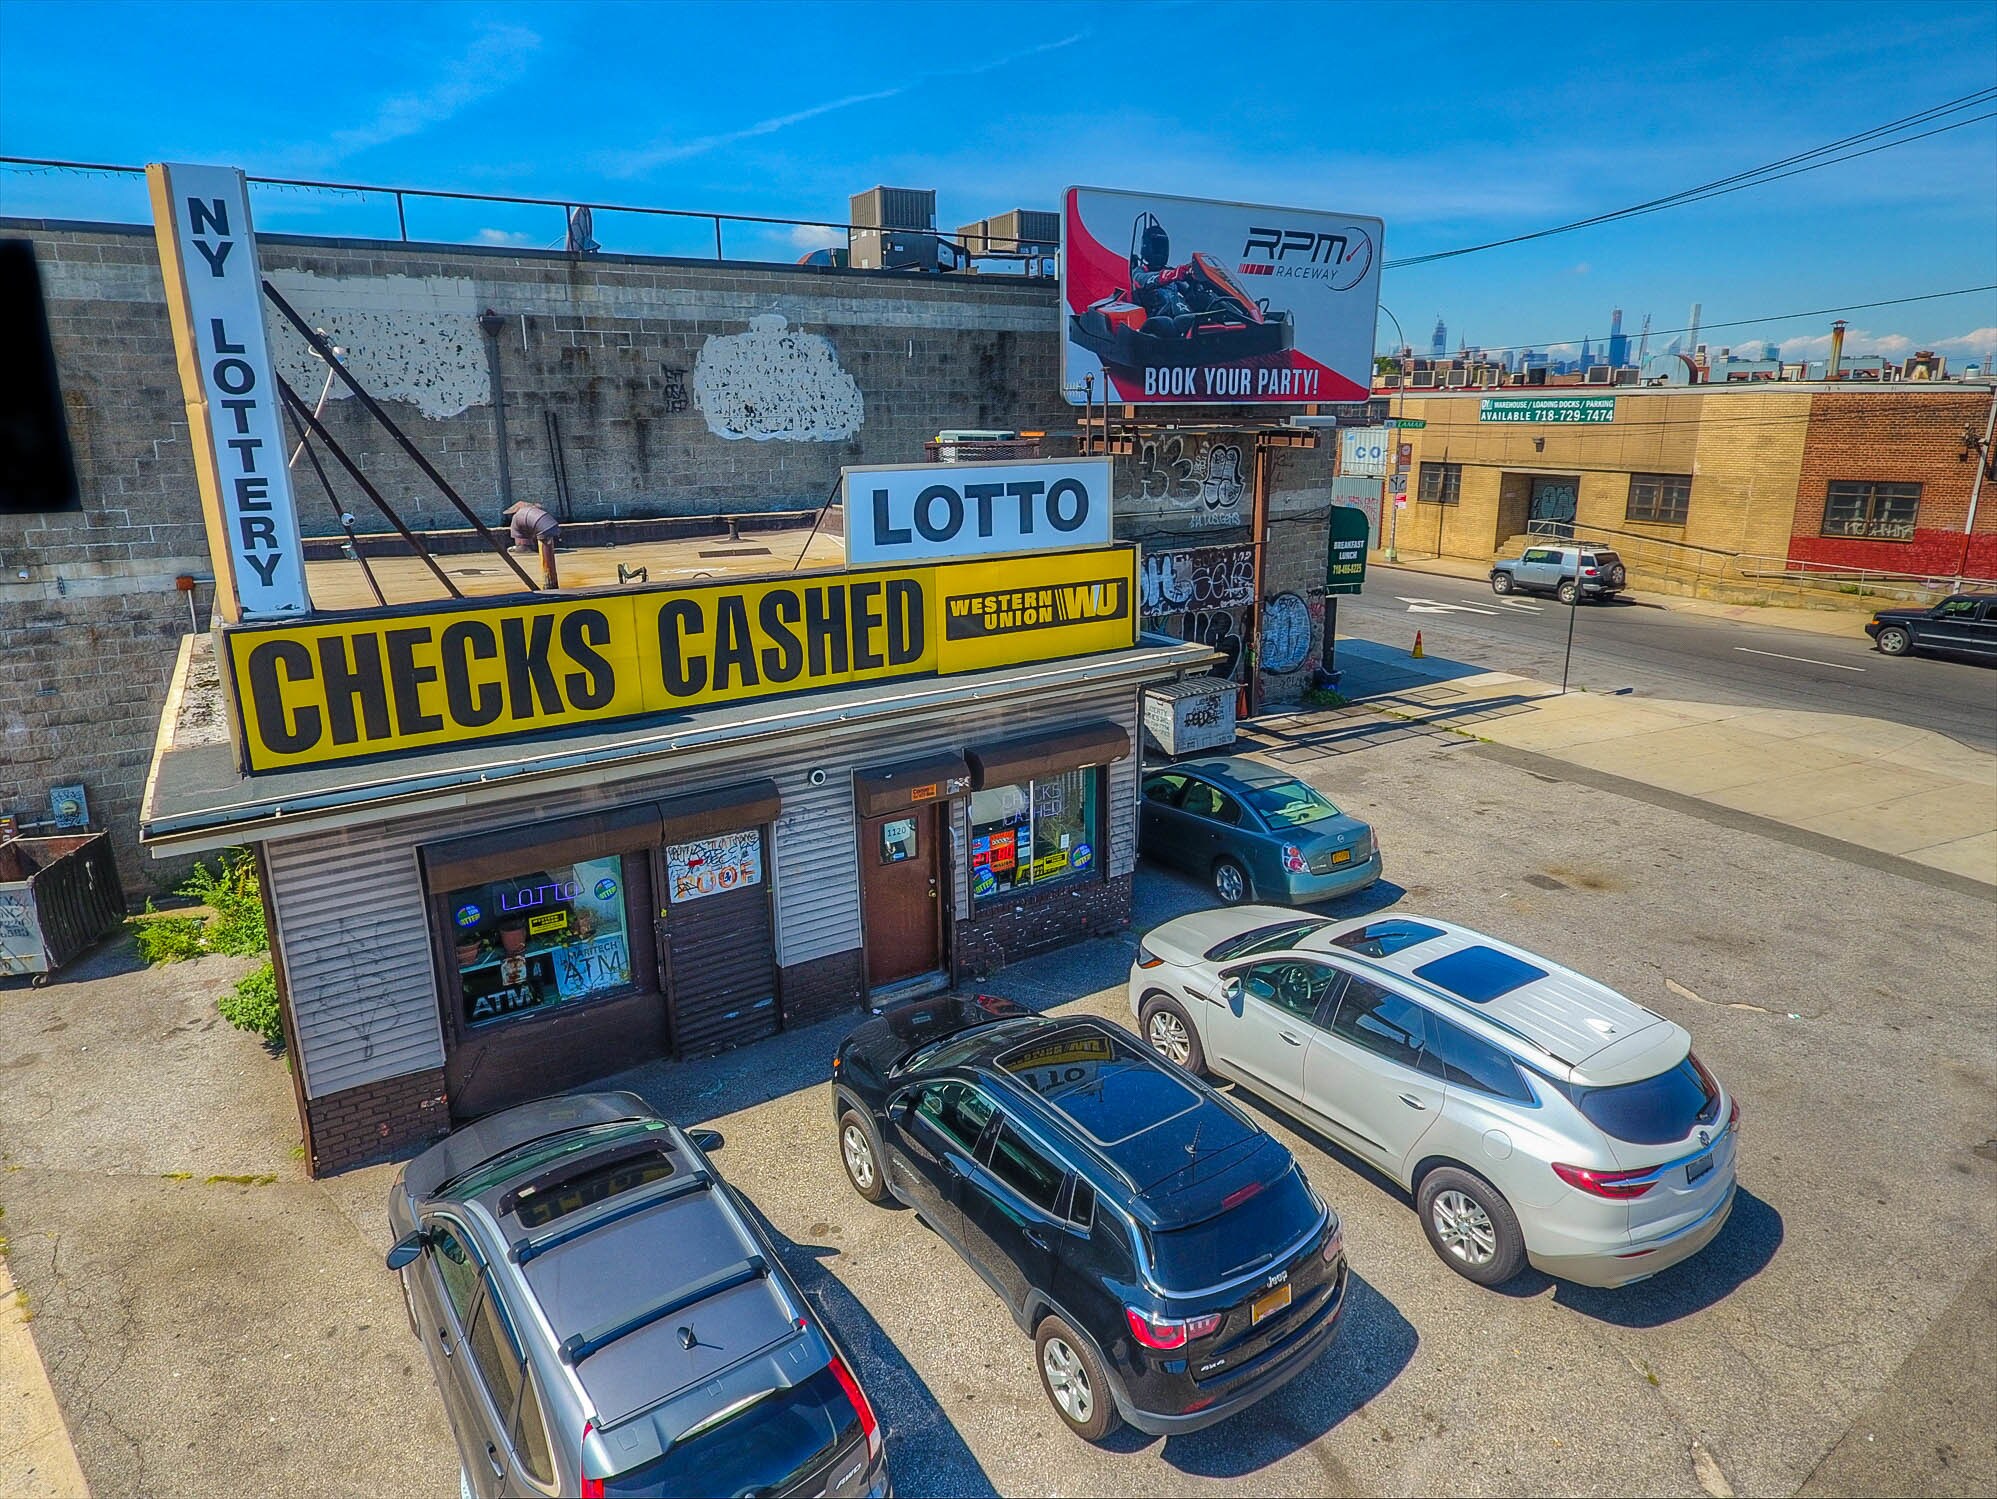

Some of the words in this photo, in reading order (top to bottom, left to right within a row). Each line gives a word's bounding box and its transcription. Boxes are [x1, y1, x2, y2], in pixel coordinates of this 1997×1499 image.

[1243, 227, 1348, 265] RPM
[1275, 266, 1338, 281] RACEWAY
[187, 197, 234, 277] NY
[211, 318, 282, 586] LOTTERY
[1145, 367, 1197, 395] BOOK
[1204, 367, 1251, 395] YOUR
[1257, 368, 1319, 395] PARTY!
[1481, 411, 1531, 421] AVAILABLE
[1535, 410, 1613, 421] 718-729-7474
[1494, 401, 1528, 409] WAREHOUSE
[1559, 400, 1580, 408] DOCKS
[1586, 400, 1613, 408] PARKING
[872, 478, 1089, 546] LOTTO
[1334, 540, 1364, 550] BREAKFAST
[1339, 551, 1358, 560] LUNCH
[950, 590, 1052, 617] WESTERN
[984, 606, 1052, 630] UNION
[248, 608, 613, 754] CHECKS
[658, 579, 925, 697] CASHED
[888, 827, 906, 837] 1120
[502, 881, 579, 911] LOTTO
[567, 941, 618, 960] MARITECH
[563, 951, 623, 985] ATM
[473, 988, 535, 1017] ATM
[1266, 1270, 1288, 1288] Jeep
[835, 1463, 862, 1490] AWD
